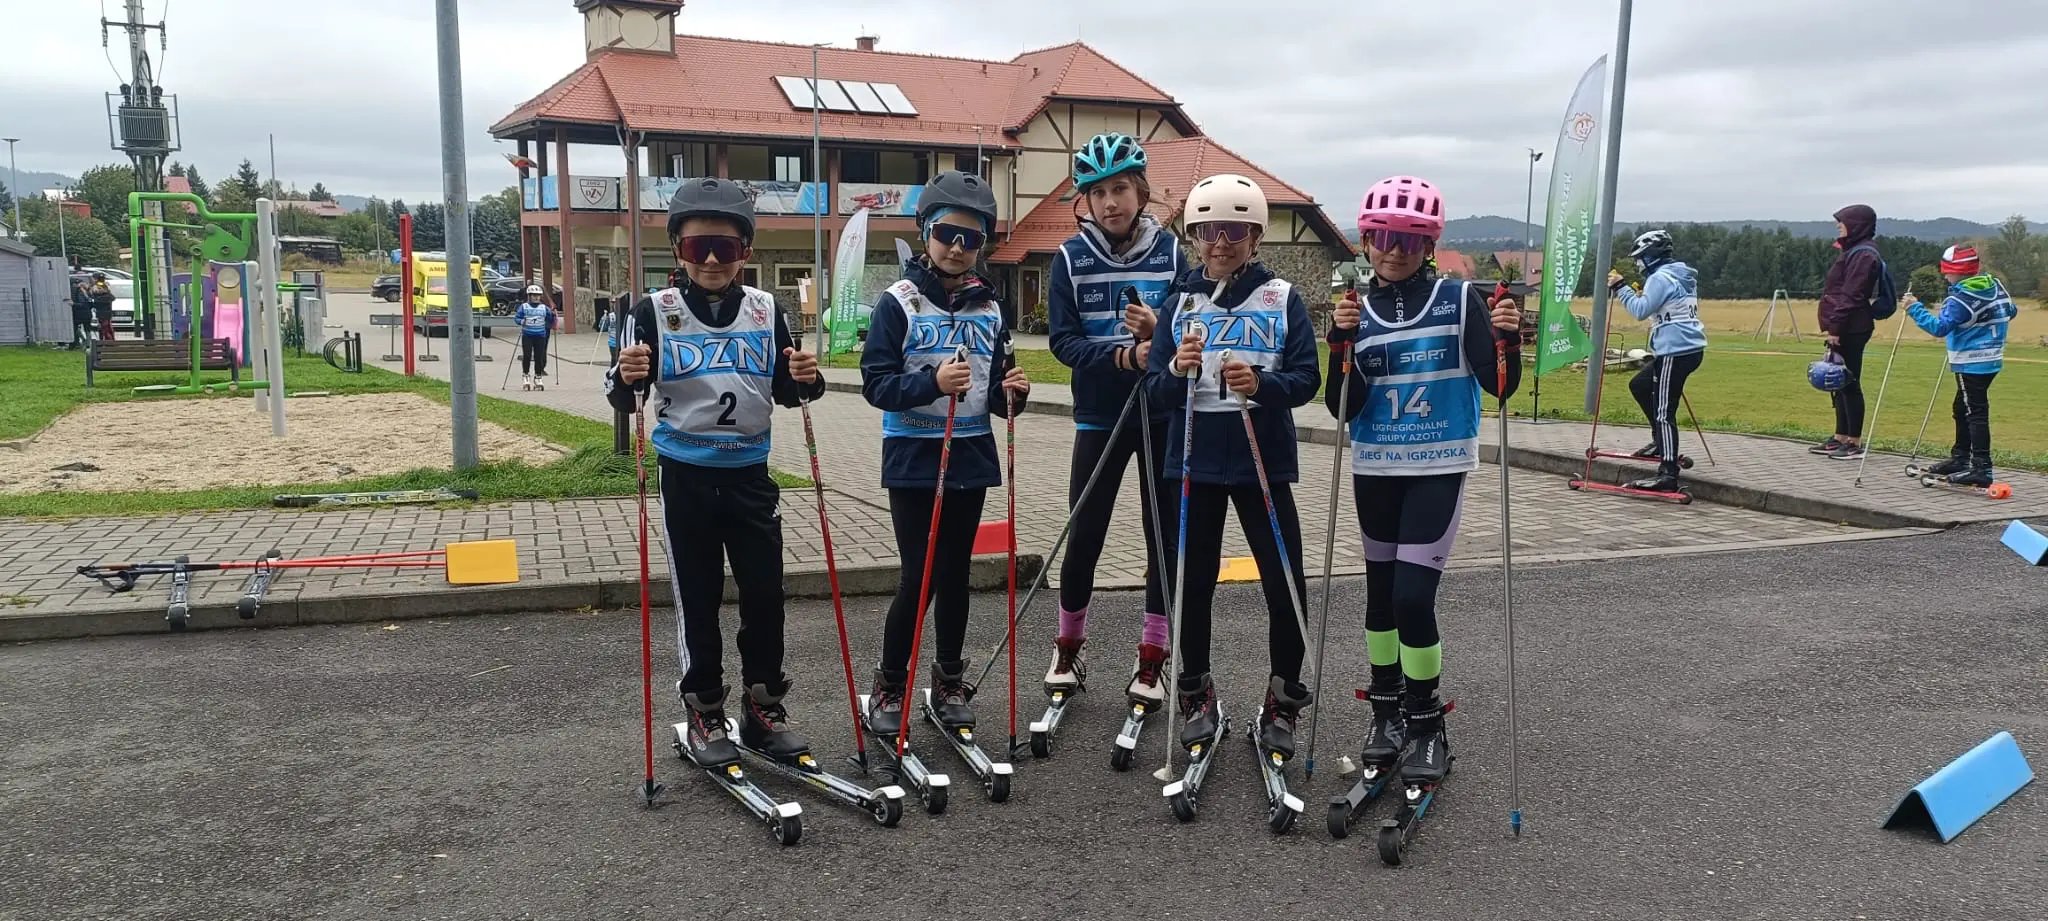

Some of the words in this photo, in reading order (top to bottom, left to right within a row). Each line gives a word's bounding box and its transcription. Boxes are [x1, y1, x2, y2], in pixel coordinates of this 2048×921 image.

[48, 261, 53, 270] 1
[1555, 239, 1564, 303] SZKOLNY
[1656, 312, 1672, 324] 34
[914, 319, 998, 350] DZN
[1180, 316, 1279, 349] DZN
[667, 336, 772, 376] DZN
[658, 397, 671, 418] 2
[717, 391, 737, 426] 2
[1384, 384, 1432, 421] 14
[1376, 434, 1406, 442] GRUPY
[1408, 430, 1443, 440] AZOTY
[1387, 420, 1449, 431] REGIONALNE
[1360, 450, 1381, 460] BIEG
[1385, 451, 1402, 460] NA
[1407, 447, 1467, 461] IGRZYSKA
